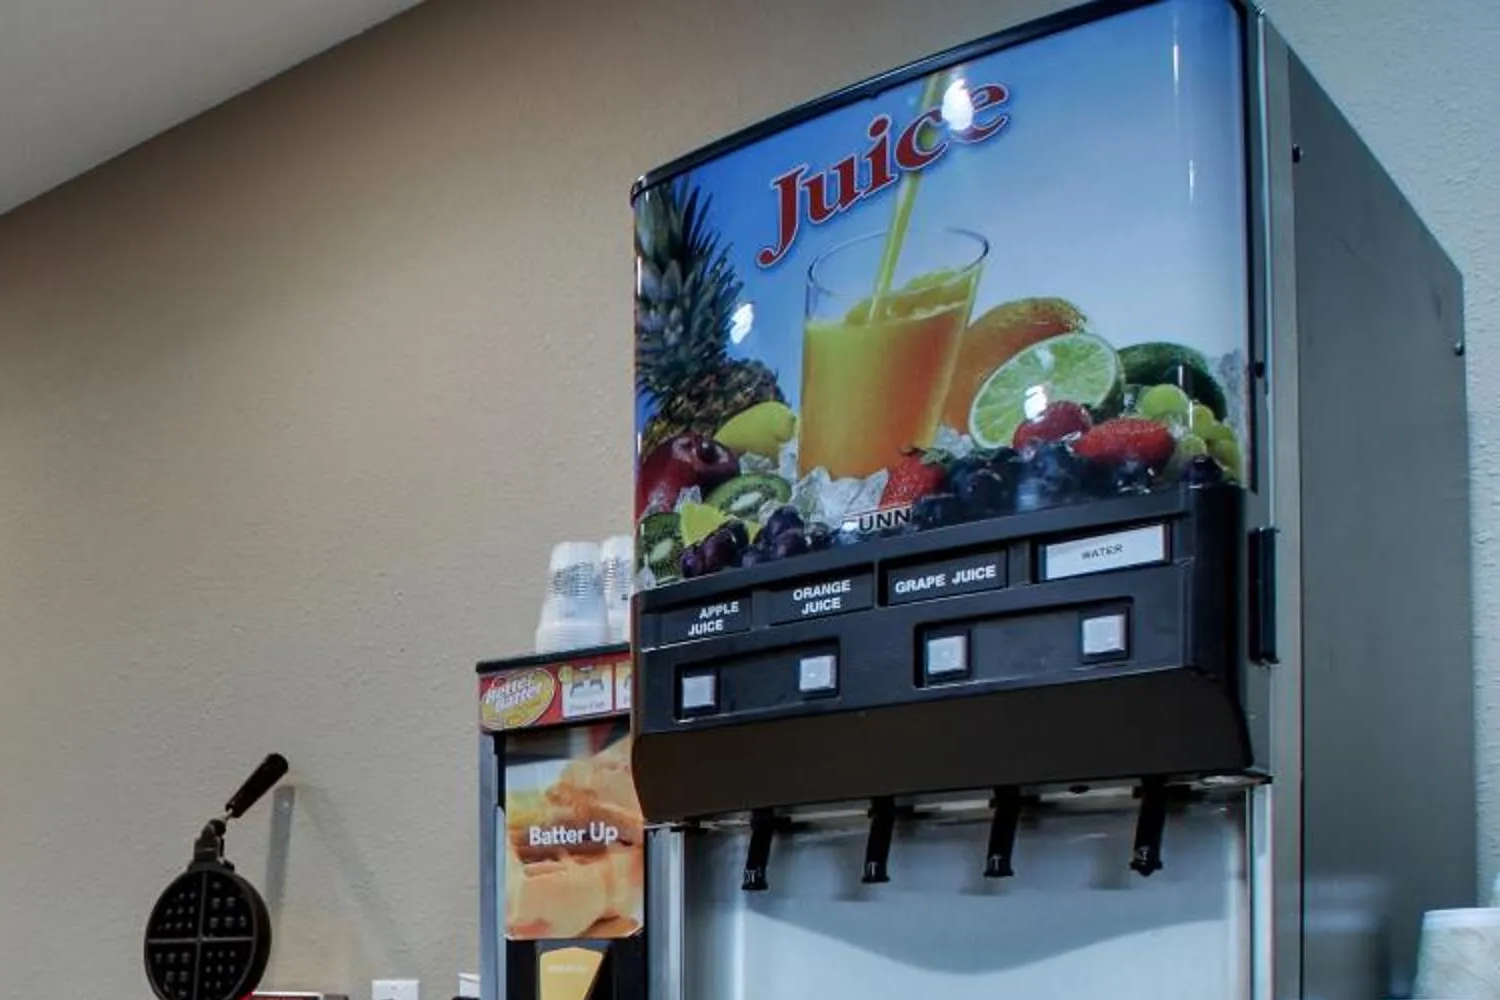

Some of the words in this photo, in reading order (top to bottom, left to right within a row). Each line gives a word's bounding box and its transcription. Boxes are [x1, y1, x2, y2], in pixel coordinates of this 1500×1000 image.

[756, 83, 1009, 268] Juice
[843, 508, 911, 532] UNN
[1081, 543, 1124, 560] WATER
[793, 579, 852, 600] ORANGE
[895, 573, 946, 594] GRAPE
[951, 565, 997, 585] JUICE
[699, 601, 740, 619] APPLE
[801, 597, 842, 615] JUICE
[688, 619, 725, 636] JUICE
[529, 825, 586, 846] Batter
[589, 821, 619, 845] Up
